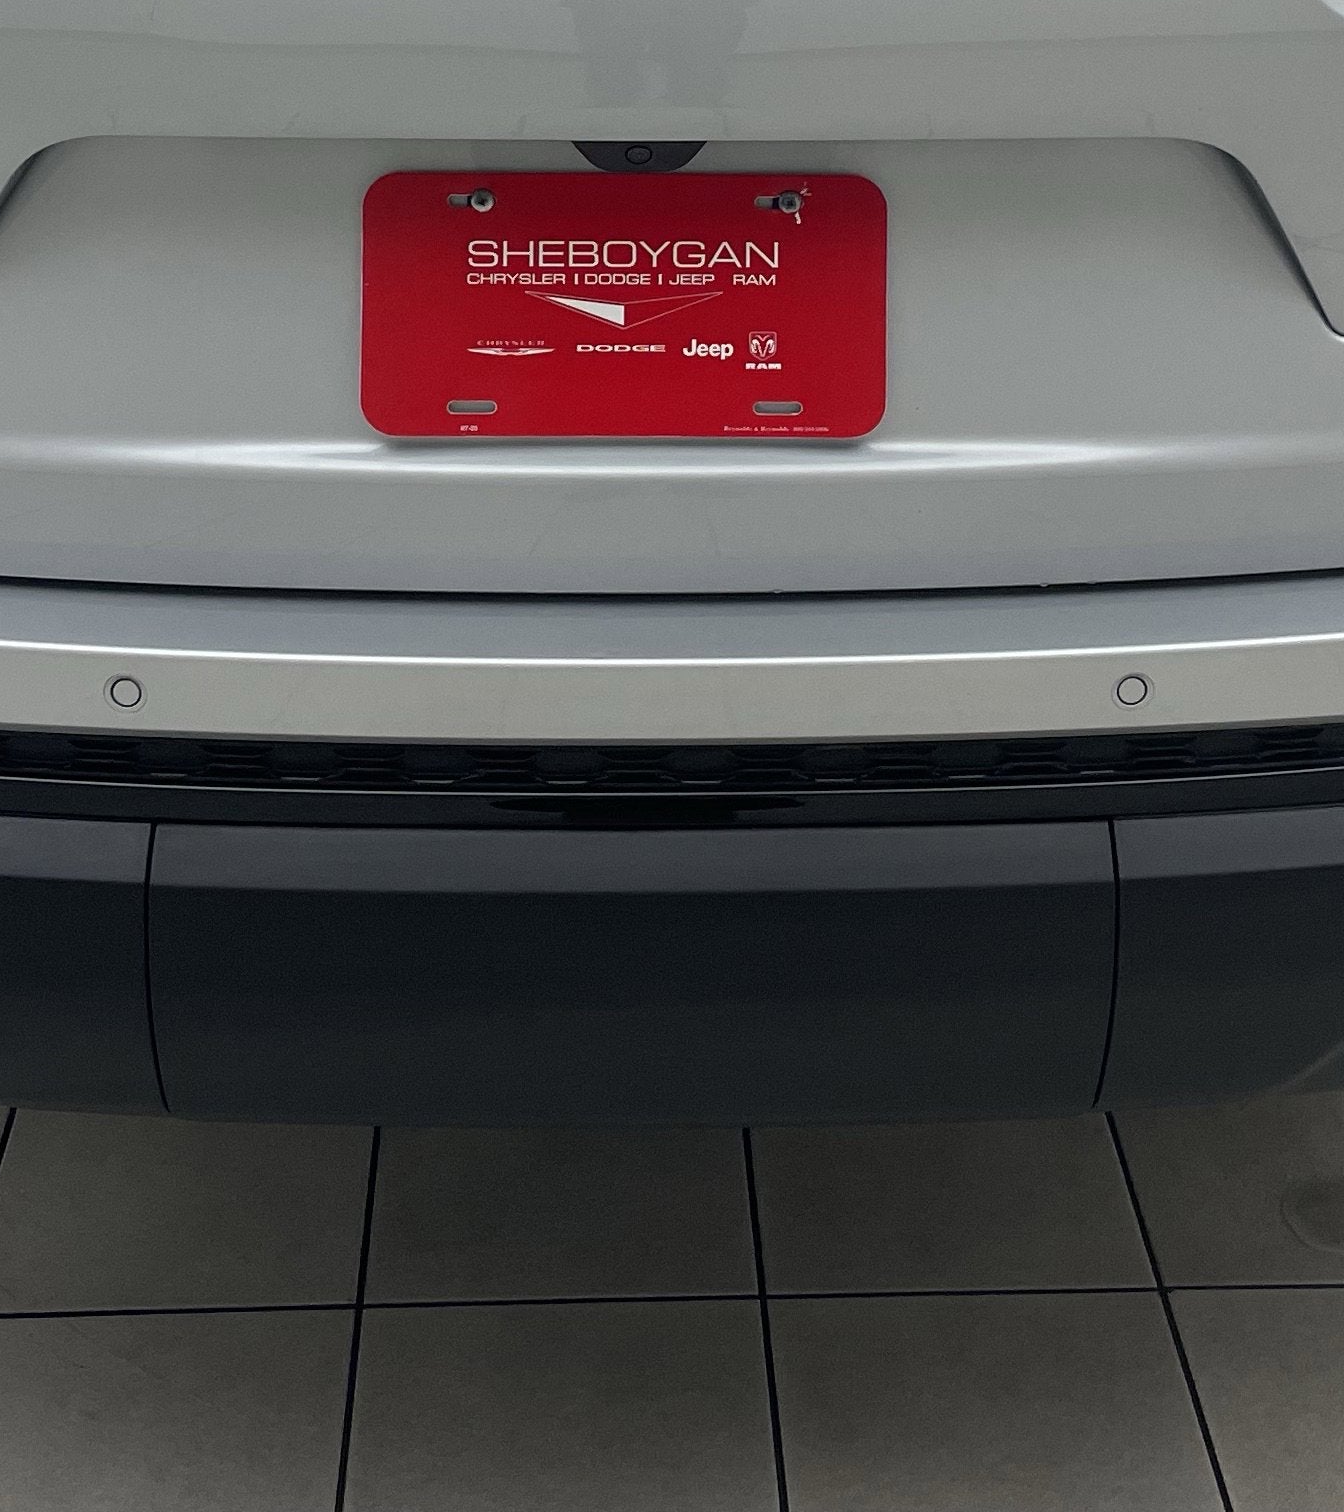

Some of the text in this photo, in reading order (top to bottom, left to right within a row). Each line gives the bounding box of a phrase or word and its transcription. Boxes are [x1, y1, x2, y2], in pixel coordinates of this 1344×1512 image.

[467, 240, 780, 269] SHEBOYGAN
[466, 272, 566, 285] CHRYSLER
[584, 273, 651, 285] DODGE
[668, 274, 715, 286] JEEP
[732, 274, 777, 286] RAM
[576, 344, 666, 353] DODGE
[682, 338, 734, 360] Jeep
[745, 362, 782, 370] RAM
